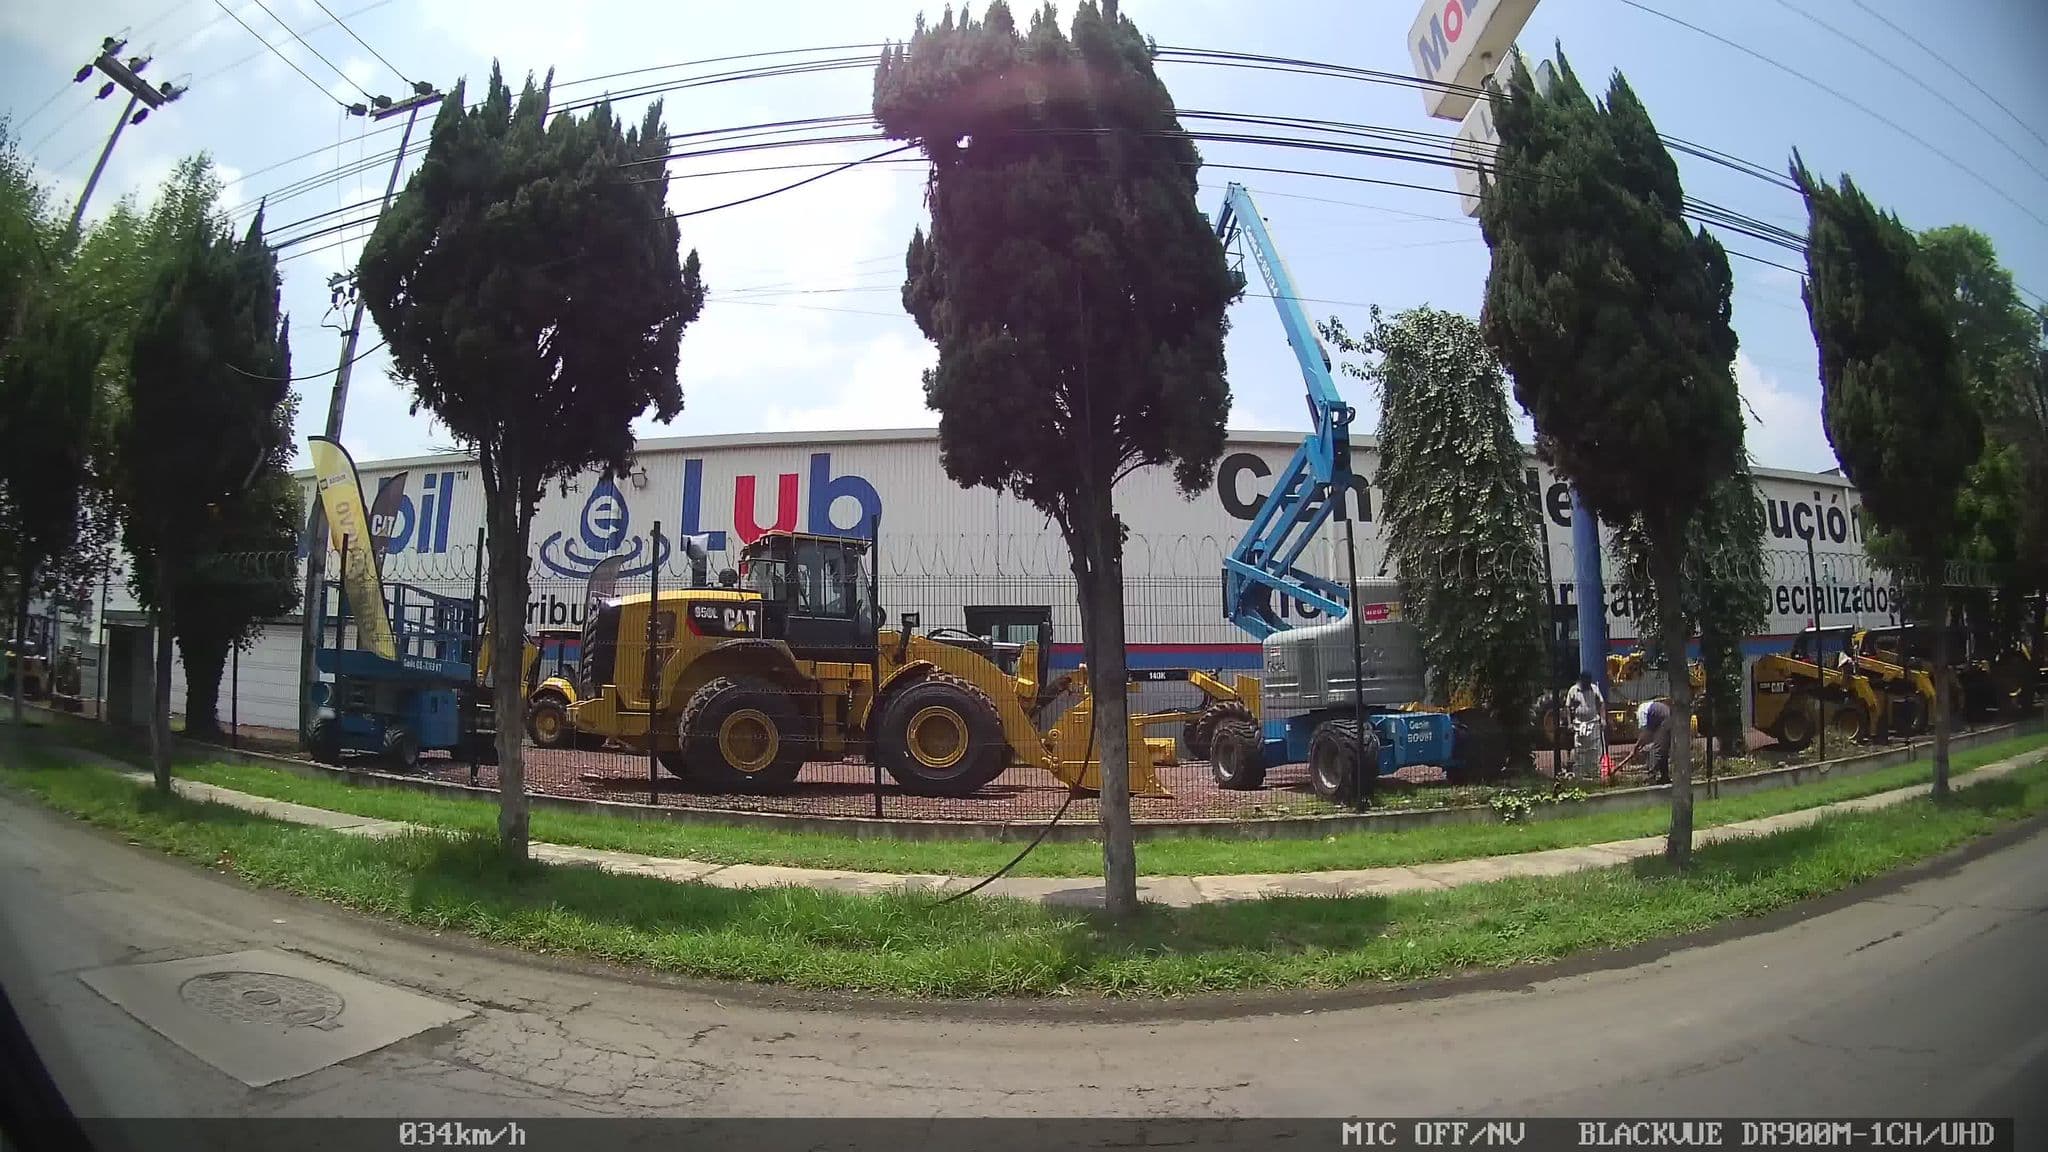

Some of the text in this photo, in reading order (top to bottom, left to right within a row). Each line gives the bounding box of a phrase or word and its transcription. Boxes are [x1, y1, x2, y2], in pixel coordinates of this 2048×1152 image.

[1418, 0, 1479, 82] Mo
[681, 453, 882, 560] Lub
[1217, 452, 1373, 522] Cen
[723, 607, 757, 633] CAT
